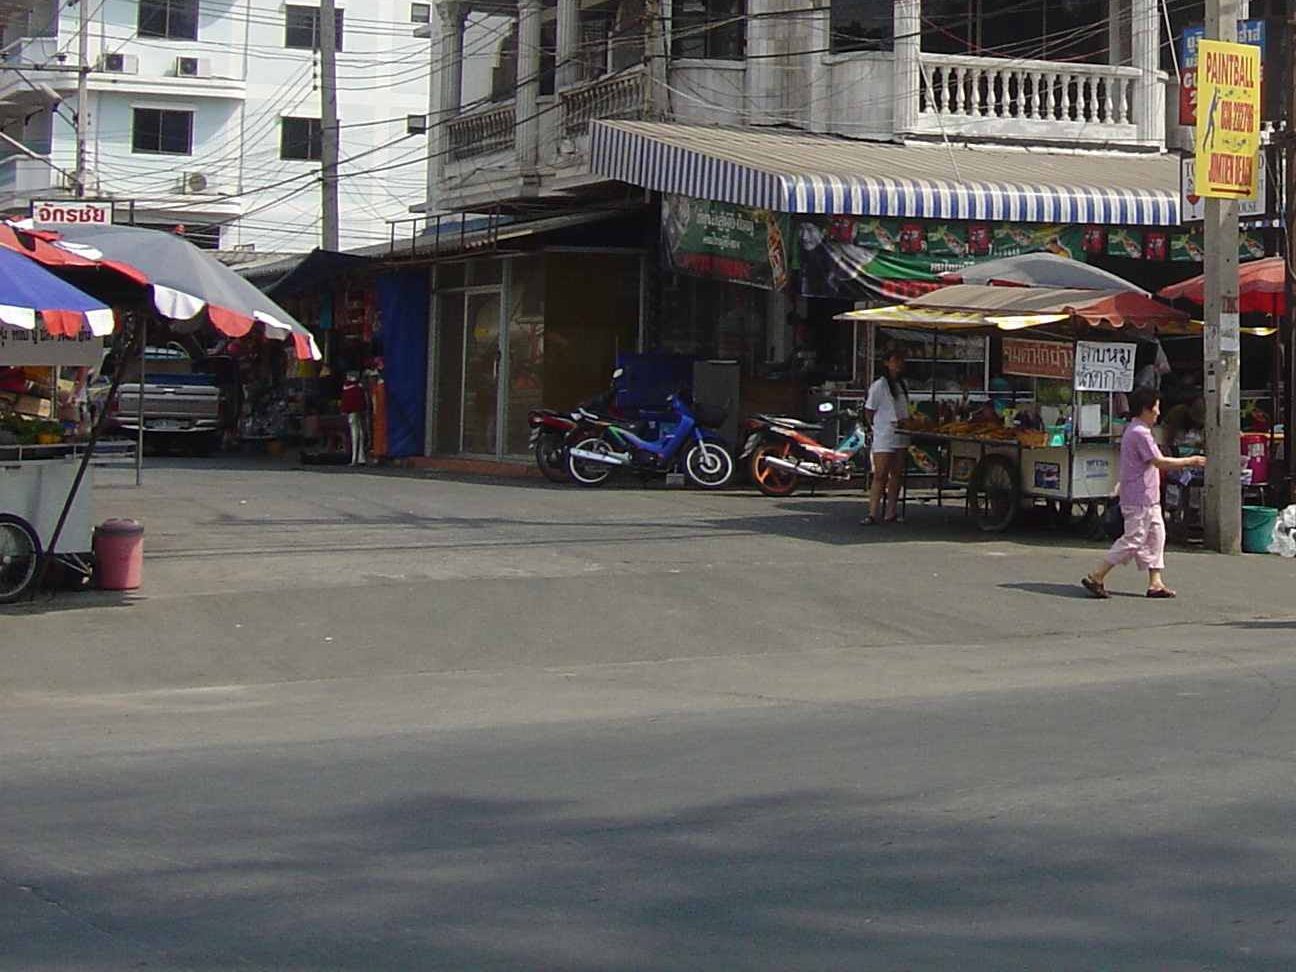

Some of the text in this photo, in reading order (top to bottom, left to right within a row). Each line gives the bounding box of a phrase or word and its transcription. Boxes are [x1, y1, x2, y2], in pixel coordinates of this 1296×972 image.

[1206, 51, 1255, 89] PAINTBALL
[38, 202, 106, 223] จักรชัย
